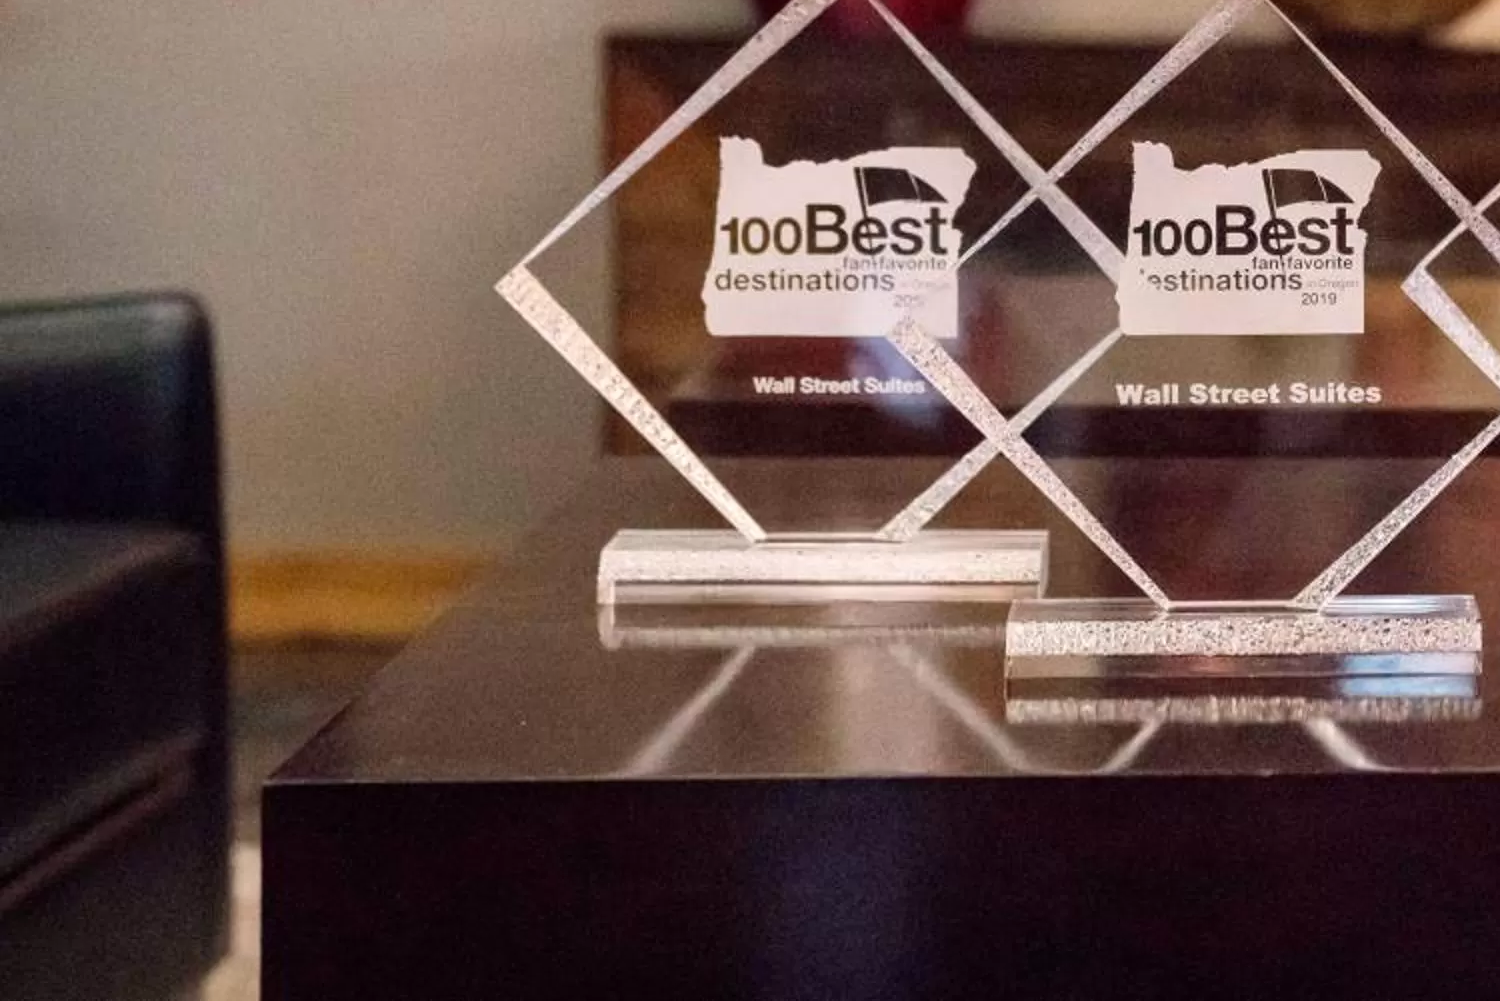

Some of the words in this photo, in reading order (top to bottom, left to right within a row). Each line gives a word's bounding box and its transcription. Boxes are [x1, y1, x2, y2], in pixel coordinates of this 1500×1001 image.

[715, 268, 895, 292] destinations
[1138, 267, 1303, 292] estinations
[1301, 292, 1337, 305] 2019
[752, 376, 796, 394] Wall
[800, 376, 860, 394] Street
[863, 376, 926, 395] Suites
[1115, 383, 1179, 405] Wall
[1189, 383, 1280, 405] Street
[1289, 382, 1382, 404] Suites
